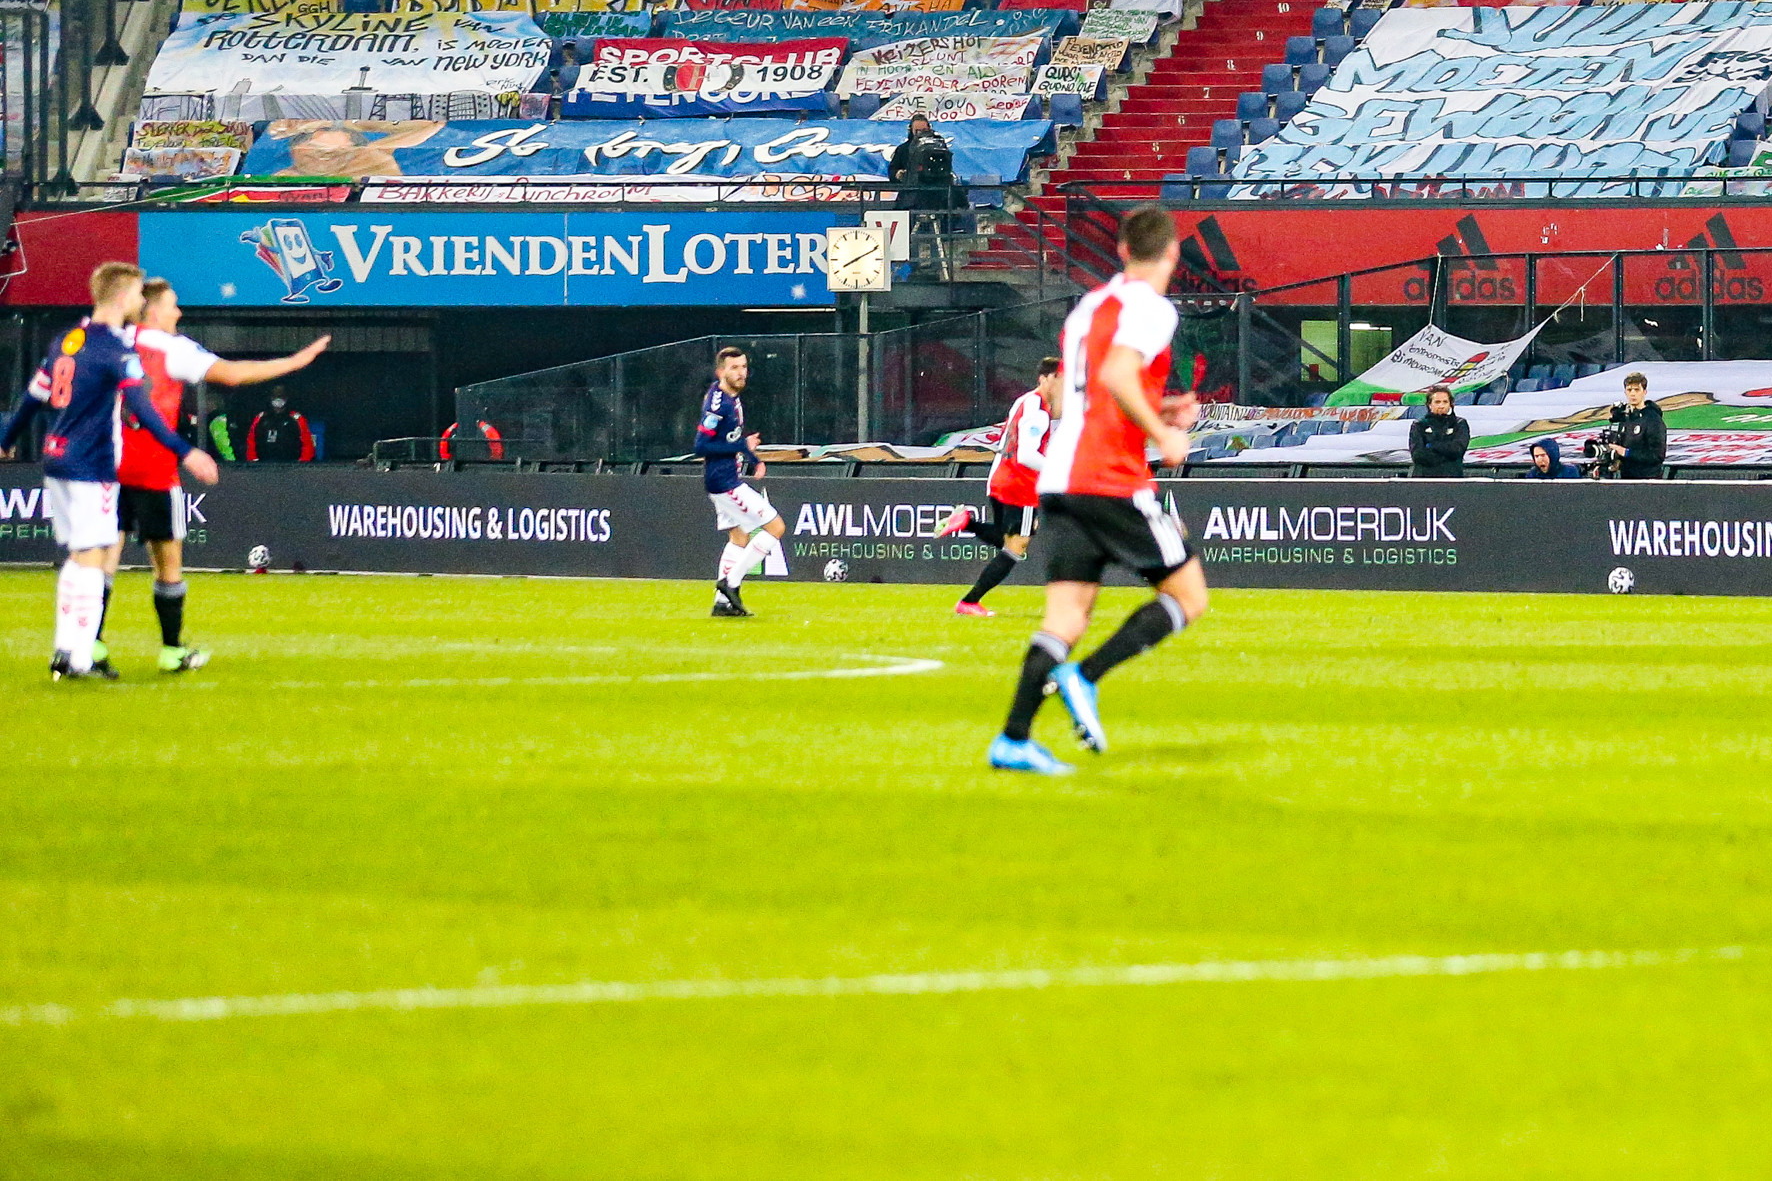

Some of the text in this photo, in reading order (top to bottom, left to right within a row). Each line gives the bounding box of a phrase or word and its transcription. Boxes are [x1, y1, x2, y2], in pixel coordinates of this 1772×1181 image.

[589, 64, 823, 84] EST. 1908
[1404, 271, 1516, 301] addas
[1654, 271, 1765, 301] addas
[51, 356, 77, 409] 8
[329, 504, 611, 542] WAREHOUSING & LOGISTICS
[1204, 505, 1457, 541] AWLMOERDIJK
[794, 543, 915, 560] WAREHOUSING
[1204, 546, 1458, 566] WAREHOUSING & LOGISTICS
